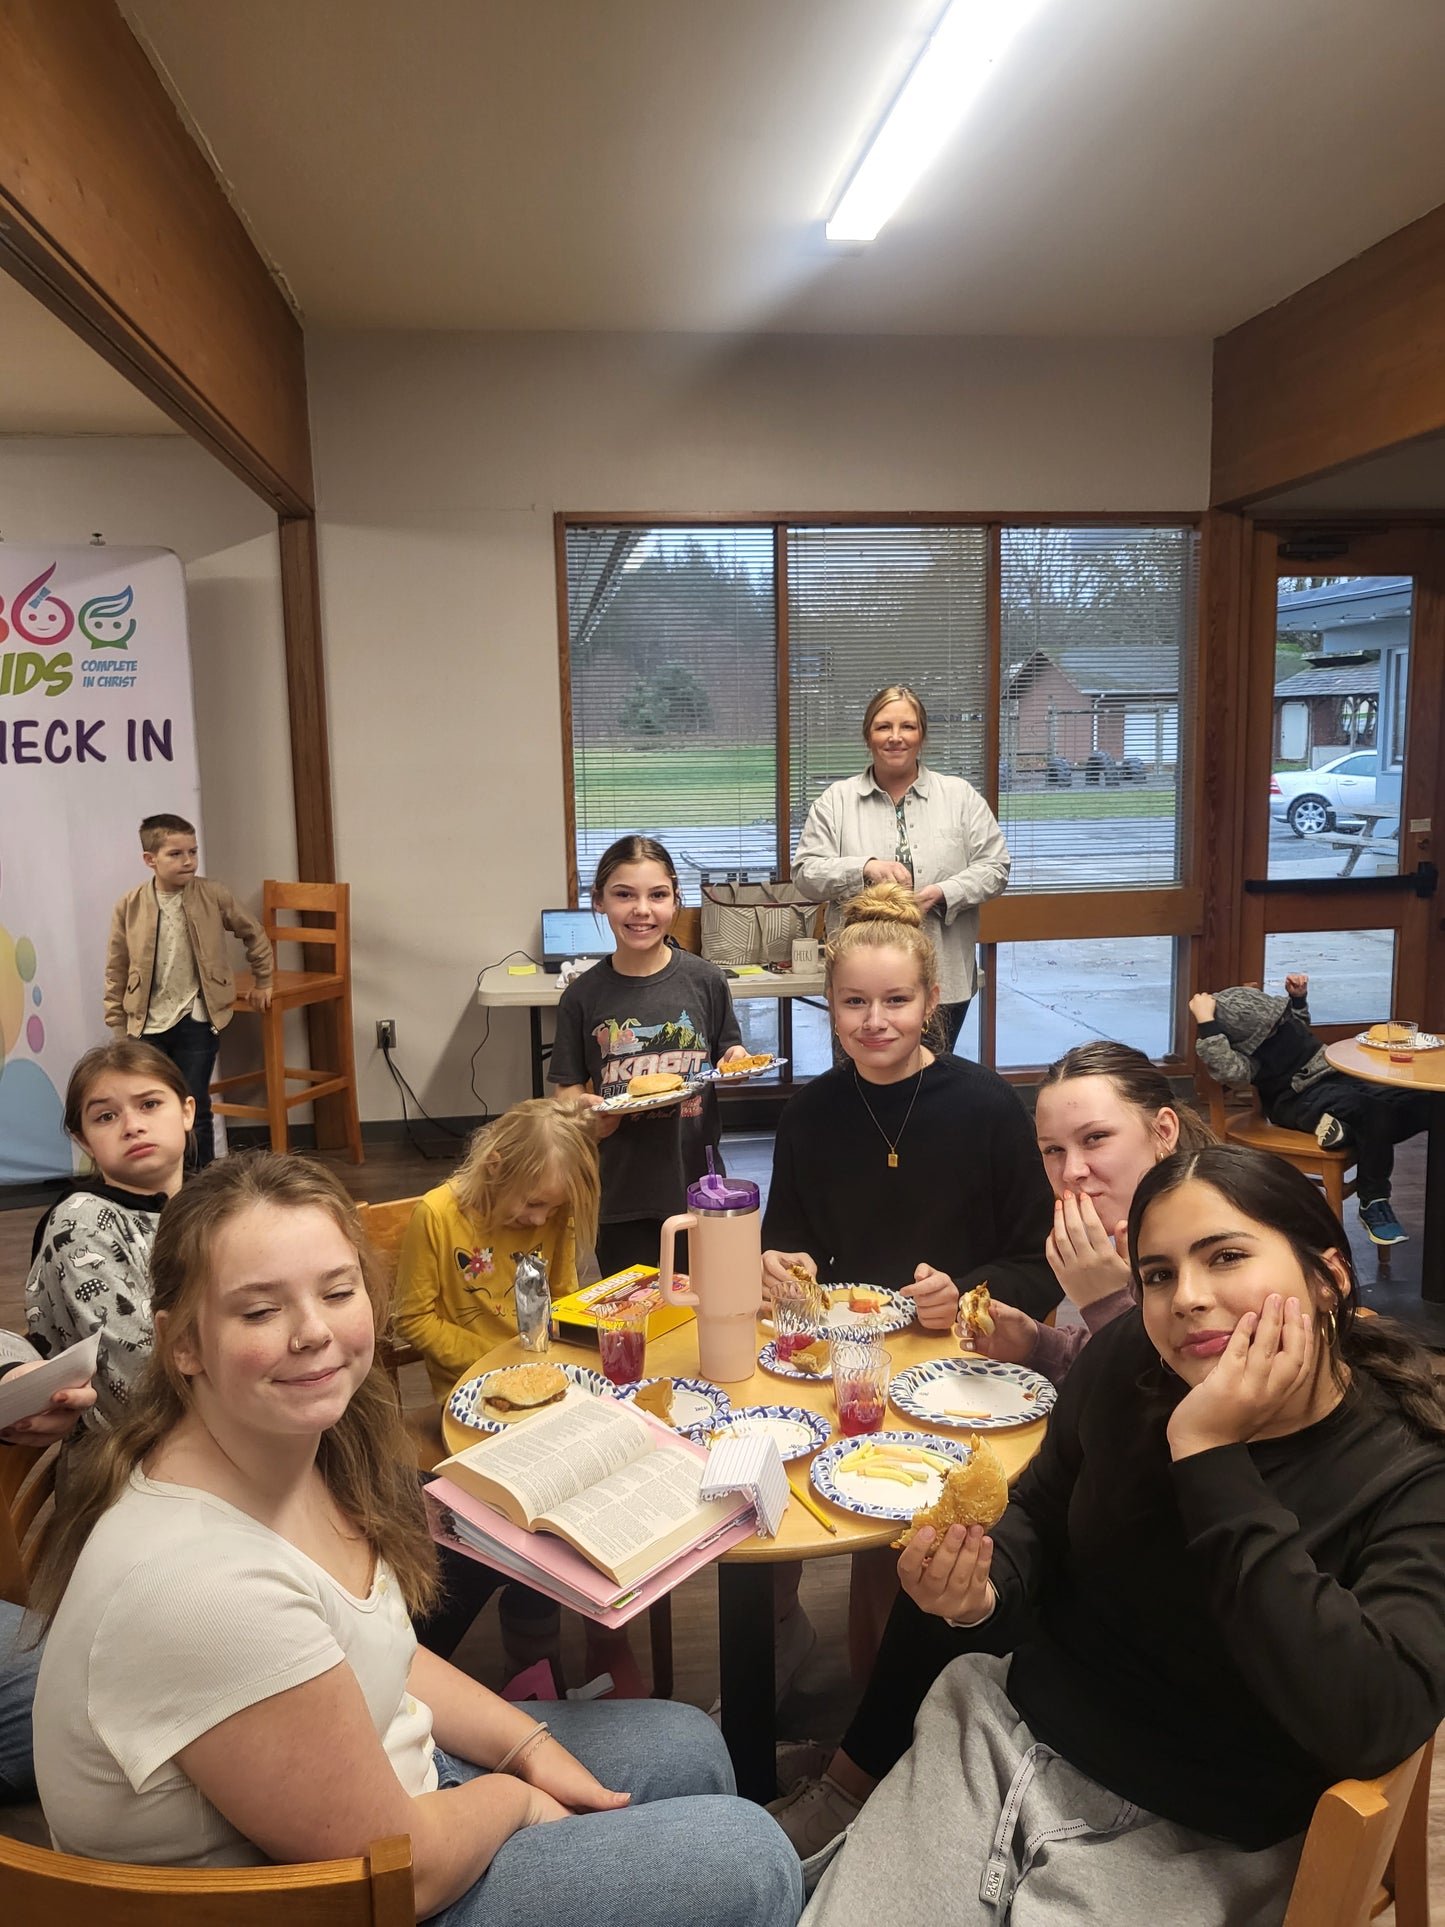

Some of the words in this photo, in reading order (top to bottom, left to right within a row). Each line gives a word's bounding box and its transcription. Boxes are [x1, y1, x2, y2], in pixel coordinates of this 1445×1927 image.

[0, 652, 73, 697] IDS
[81, 660, 138, 672] COMPLETE
[83, 676, 95, 688] IN
[97, 676, 137, 688] CHRIST
[127, 719, 174, 763] IN
